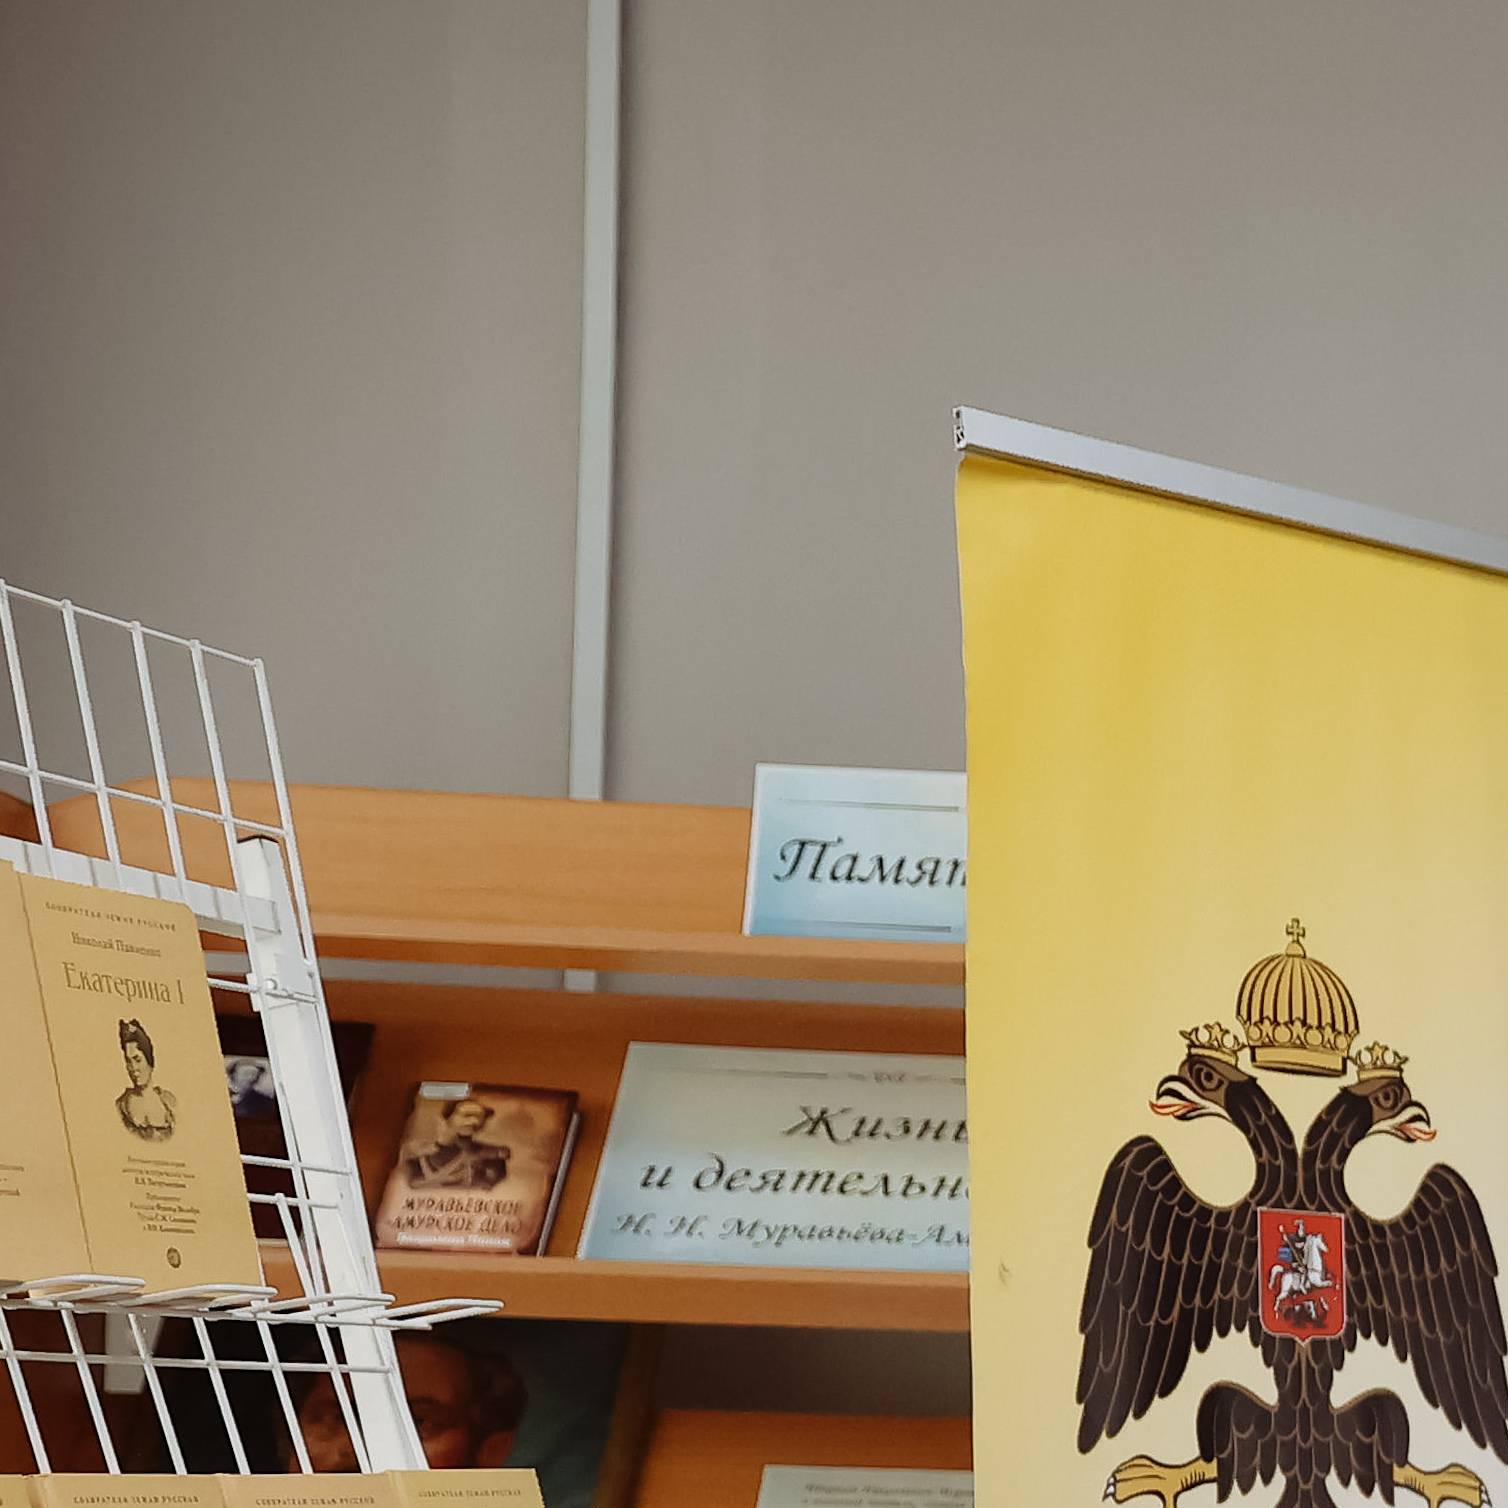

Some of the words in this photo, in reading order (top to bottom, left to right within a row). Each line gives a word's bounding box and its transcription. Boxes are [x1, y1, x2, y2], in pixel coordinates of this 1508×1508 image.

[62, 961, 171, 1004] Екатерина
[177, 979, 185, 1005] I
[638, 1161, 673, 1191] и
